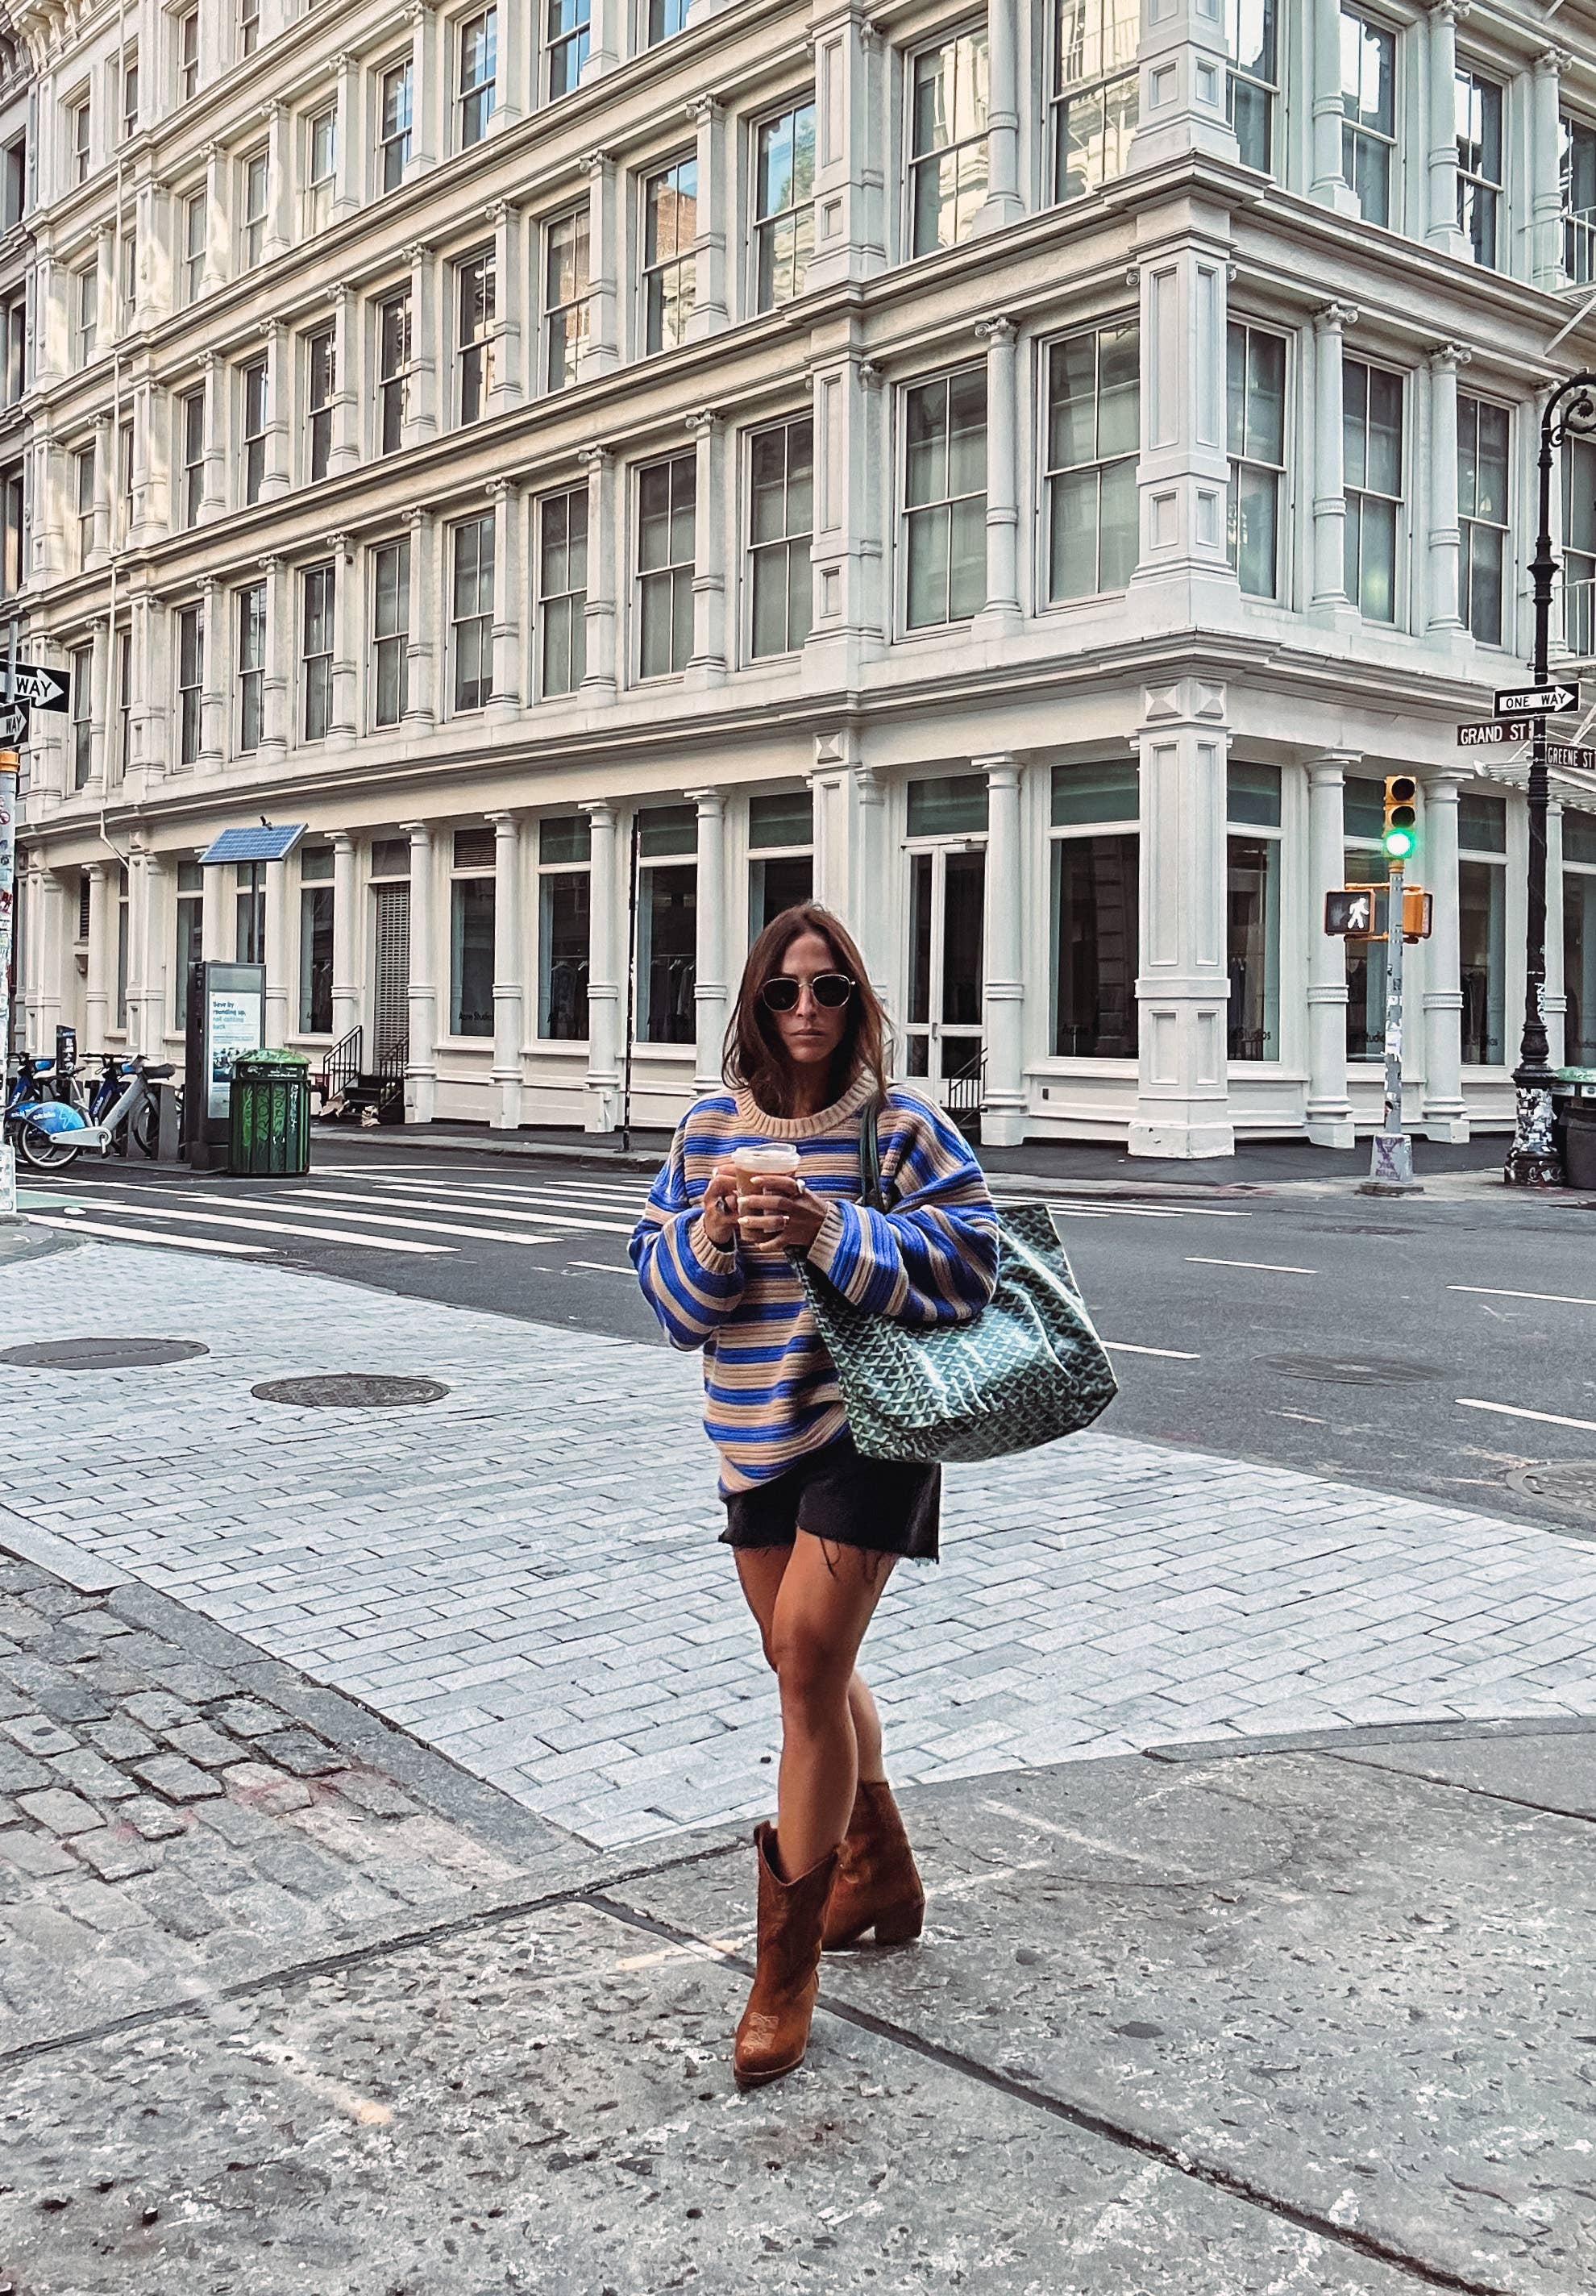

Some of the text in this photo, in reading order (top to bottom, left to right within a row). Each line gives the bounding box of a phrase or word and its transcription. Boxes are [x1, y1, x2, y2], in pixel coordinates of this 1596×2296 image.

[17, 676, 52, 697] WAY
[1506, 693, 1567, 709] ONE WAY
[6, 715, 22, 734] WAY
[1461, 723, 1527, 745] GRAND ST
[1548, 747, 1594, 768] GREENE ST
